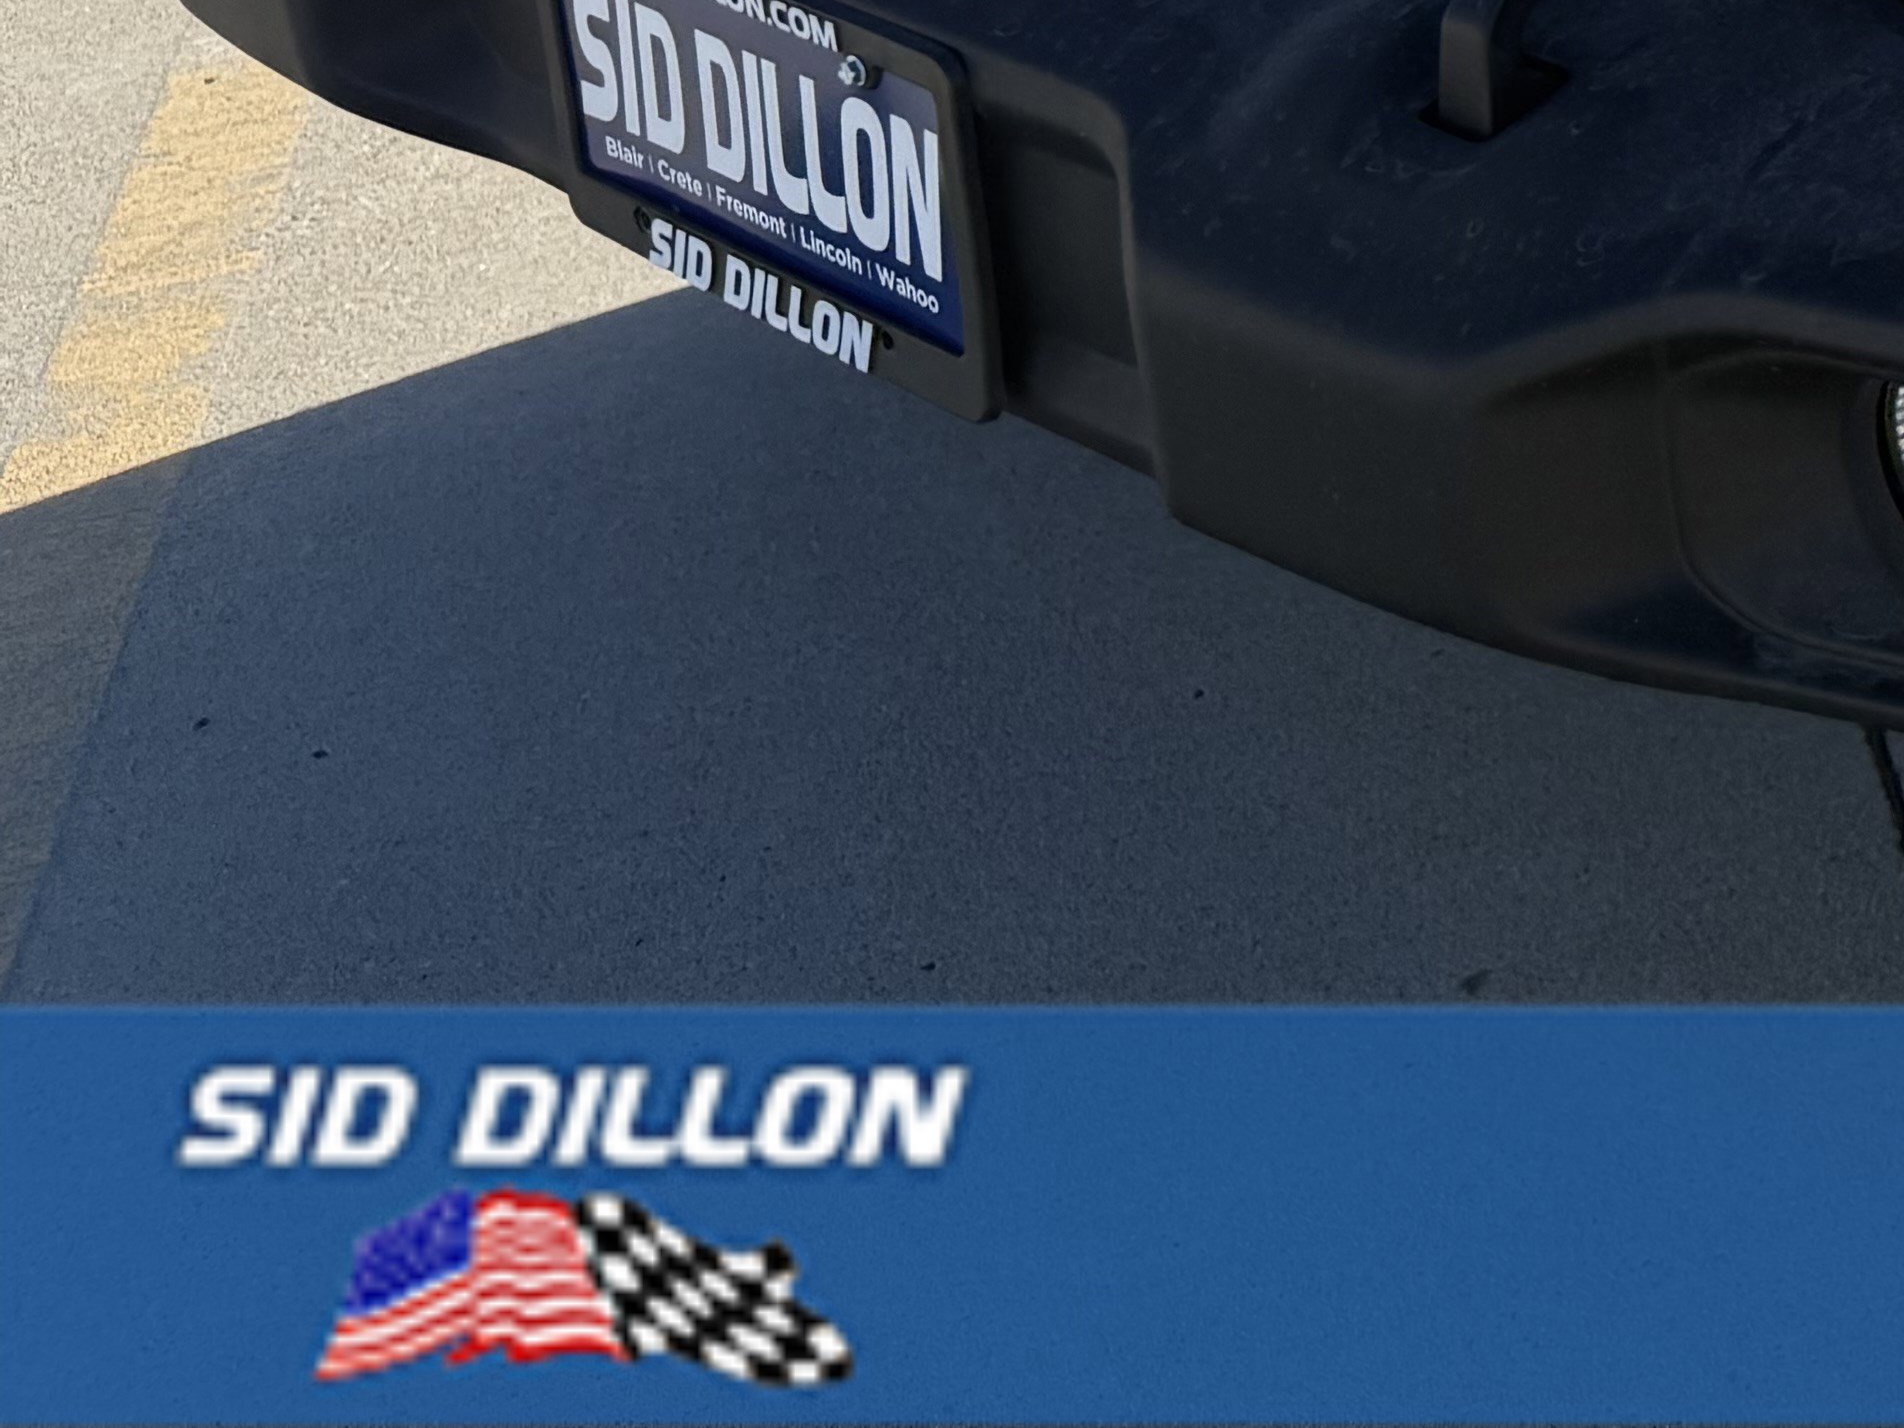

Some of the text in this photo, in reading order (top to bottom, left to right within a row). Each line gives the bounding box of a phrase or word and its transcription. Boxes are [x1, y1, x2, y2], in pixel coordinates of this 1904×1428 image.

[604, 135, 939, 314] Blair Crete Fremont Lincoln Wahoo
[693, 28, 943, 283] DILLON
[649, 217, 873, 373] SID DILLON
